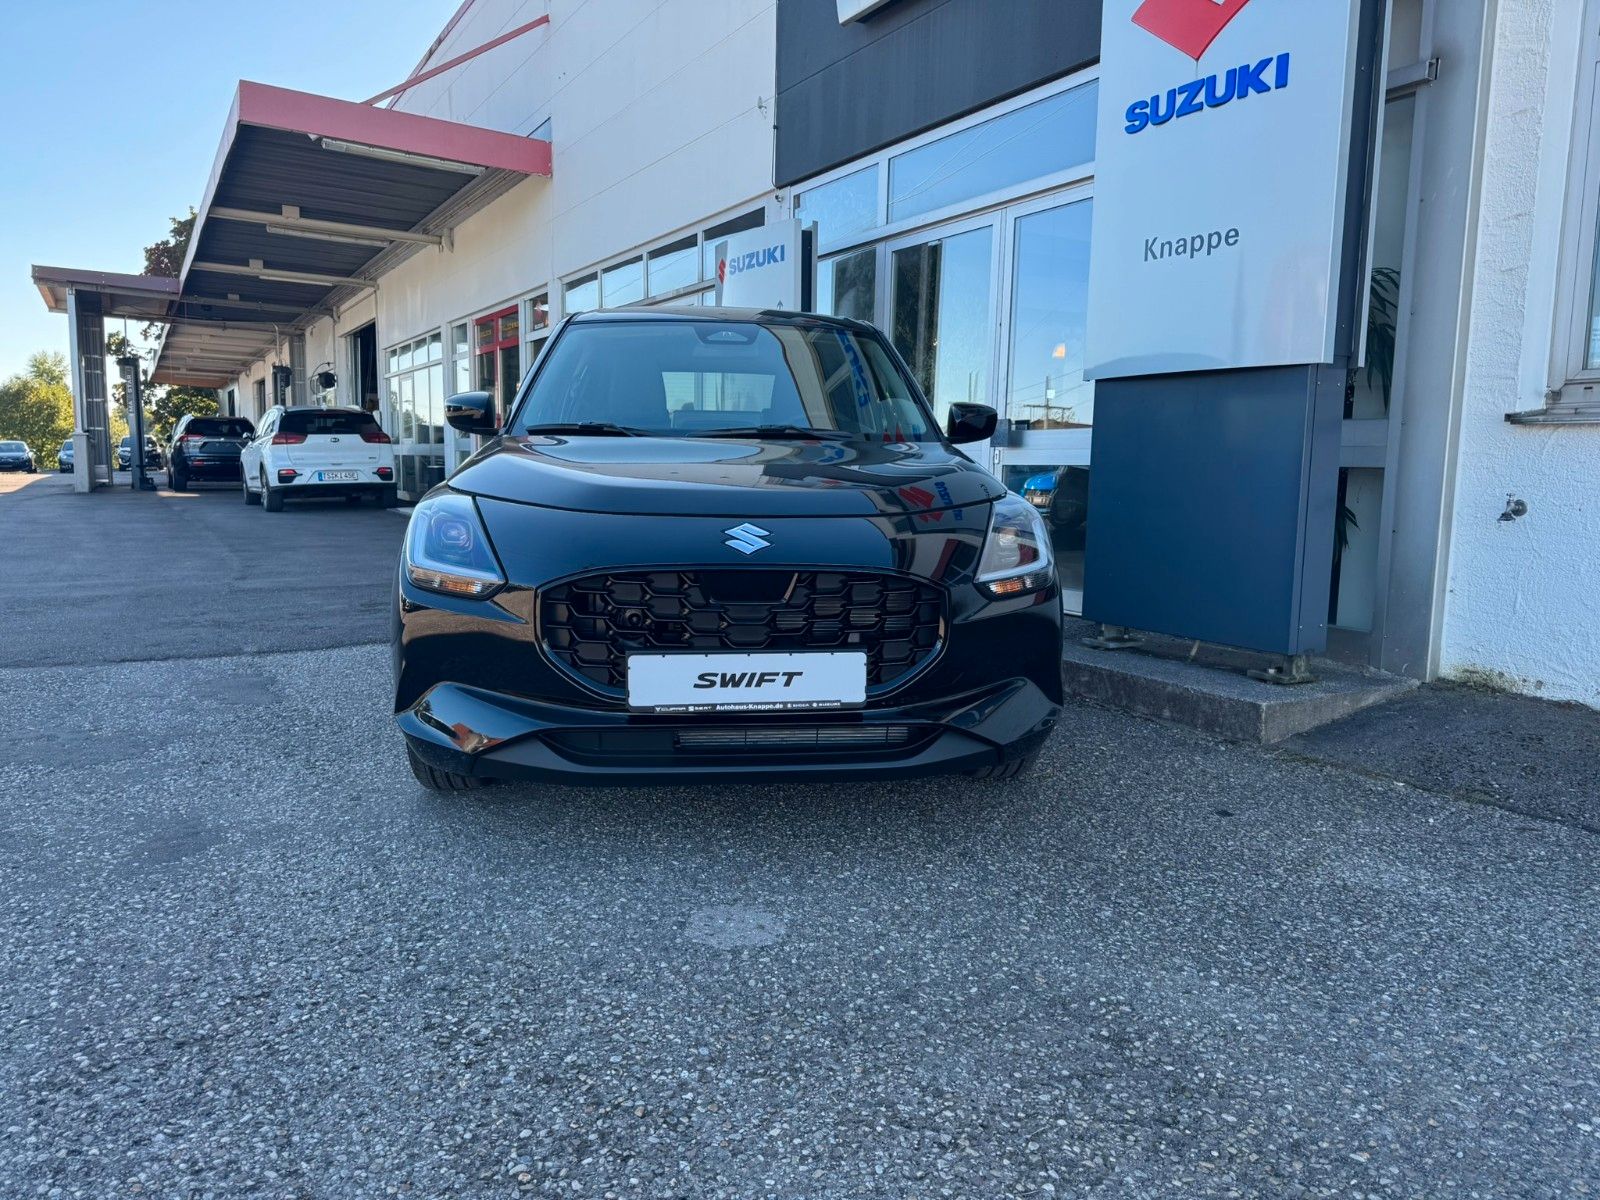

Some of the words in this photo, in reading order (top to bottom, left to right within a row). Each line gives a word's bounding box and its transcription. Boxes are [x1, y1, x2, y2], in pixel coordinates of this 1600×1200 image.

[1125, 52, 1290, 134] SUZUKI
[728, 244, 785, 275] SUZUKI
[1143, 227, 1240, 262] Knappe
[693, 671, 804, 689] SWIFT
[716, 702, 784, 710] Autohaus-Knappe.de
